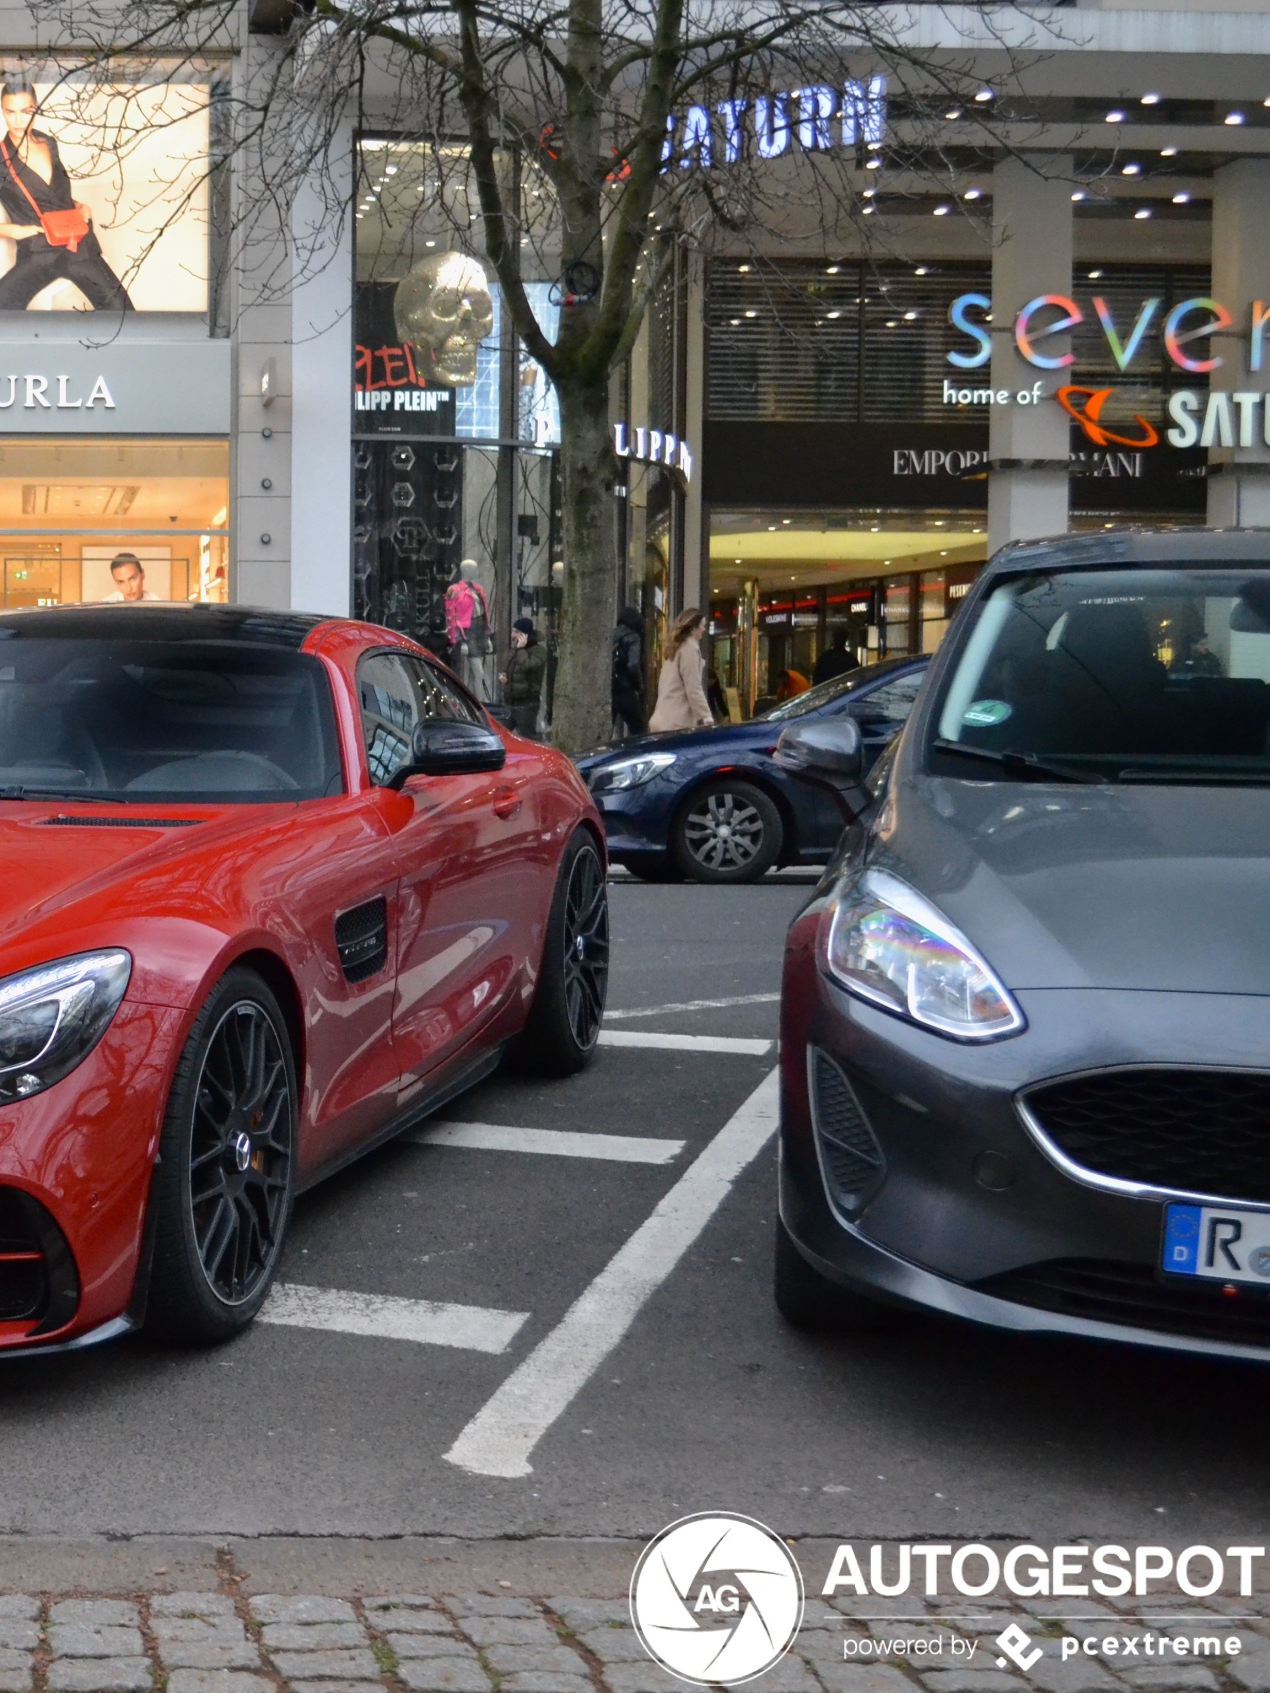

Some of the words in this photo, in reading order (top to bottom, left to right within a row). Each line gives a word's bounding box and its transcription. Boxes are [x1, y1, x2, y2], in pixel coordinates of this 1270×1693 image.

[659, 76, 884, 175] ATURN
[943, 380, 1009, 405] home
[1016, 381, 1042, 405] of
[1167, 391, 1270, 448] SAT
[1173, 1246, 1188, 1262] D
[1205, 1216, 1242, 1271] R
